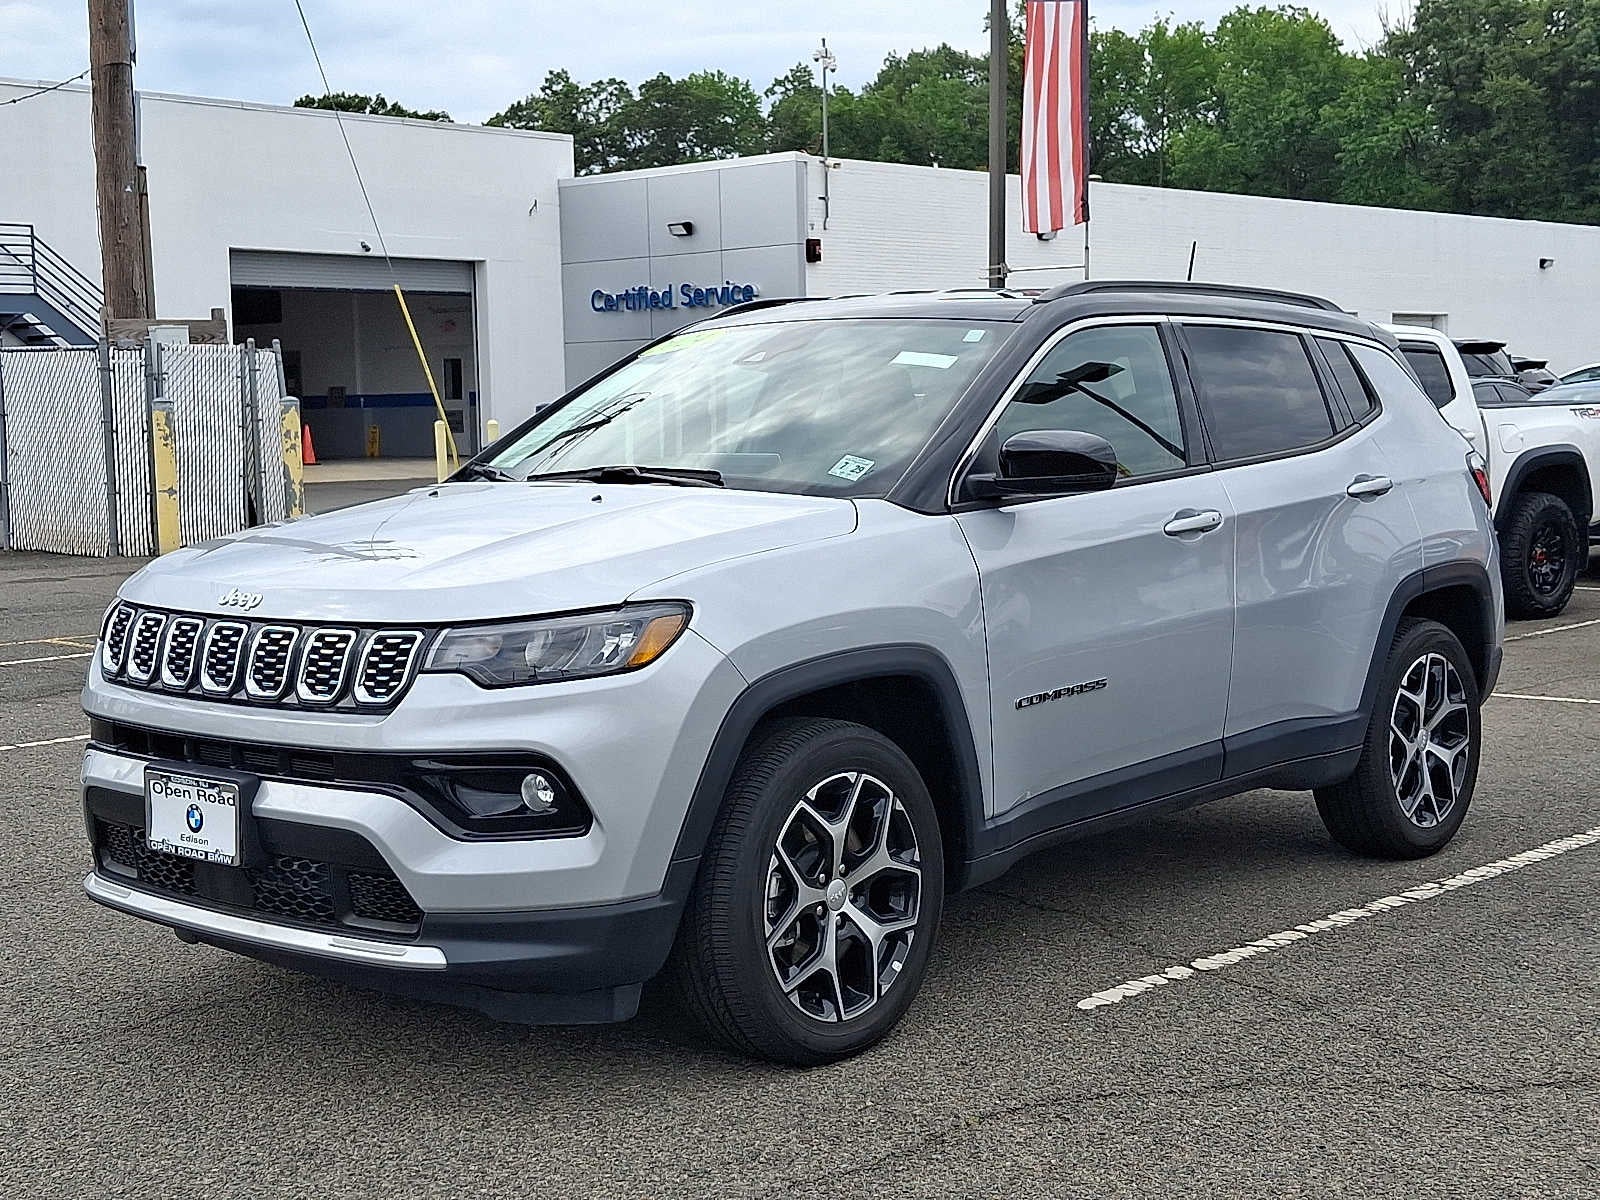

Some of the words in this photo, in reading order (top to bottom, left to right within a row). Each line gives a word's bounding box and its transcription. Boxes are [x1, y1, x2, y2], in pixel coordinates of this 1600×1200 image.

[590, 284, 673, 313] Certified
[680, 280, 758, 308] Service
[1569, 407, 1595, 420] TRD
[217, 586, 264, 612] Jeep
[1015, 677, 1108, 710] COMPASS
[152, 781, 191, 799] Open
[196, 788, 236, 807] Road
[180, 833, 209, 846] Edison
[150, 841, 176, 854] OPEN
[177, 846, 206, 860] ROAD
[207, 852, 233, 865] BMW
